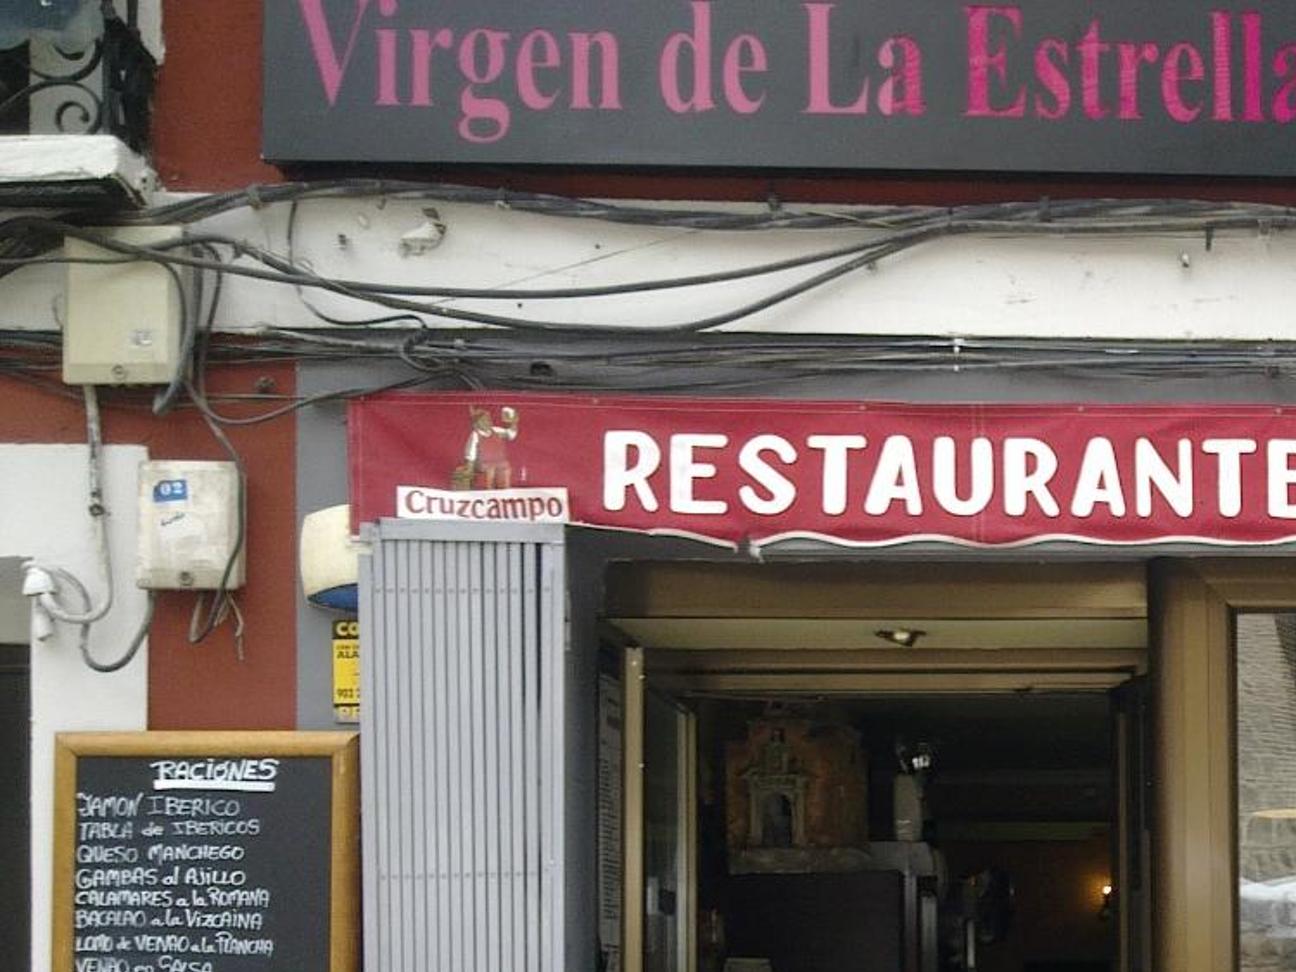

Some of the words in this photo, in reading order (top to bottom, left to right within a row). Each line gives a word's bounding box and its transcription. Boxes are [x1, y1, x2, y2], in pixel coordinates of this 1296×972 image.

[301, 0, 623, 143] Virgen
[659, 0, 768, 114] de
[801, 2, 927, 116] La
[403, 489, 564, 522] Cruzcampo
[150, 758, 280, 782] RACIONES
[77, 792, 144, 817] JAMON
[146, 795, 240, 817] IBERICO
[79, 821, 133, 840] TABLA
[141, 821, 165, 836] de
[171, 819, 260, 836] IBERICOS
[77, 845, 138, 863] QUESO
[148, 844, 245, 865] MANCHEGO
[75, 867, 159, 889] GAMBAS
[161, 866, 179, 885] al
[184, 867, 246, 886] AJILLO
[75, 889, 173, 908] CALAMARES
[175, 895, 189, 907] a
[192, 890, 208, 907] la
[206, 886, 270, 908] ROMANA
[75, 910, 146, 928] BACALAO
[151, 917, 165, 927] a
[165, 909, 184, 927] la
[184, 909, 262, 930] VIZCAINA
[75, 934, 113, 952] LOMO
[116, 936, 131, 950] de
[214, 931, 274, 957] PLANCHA
